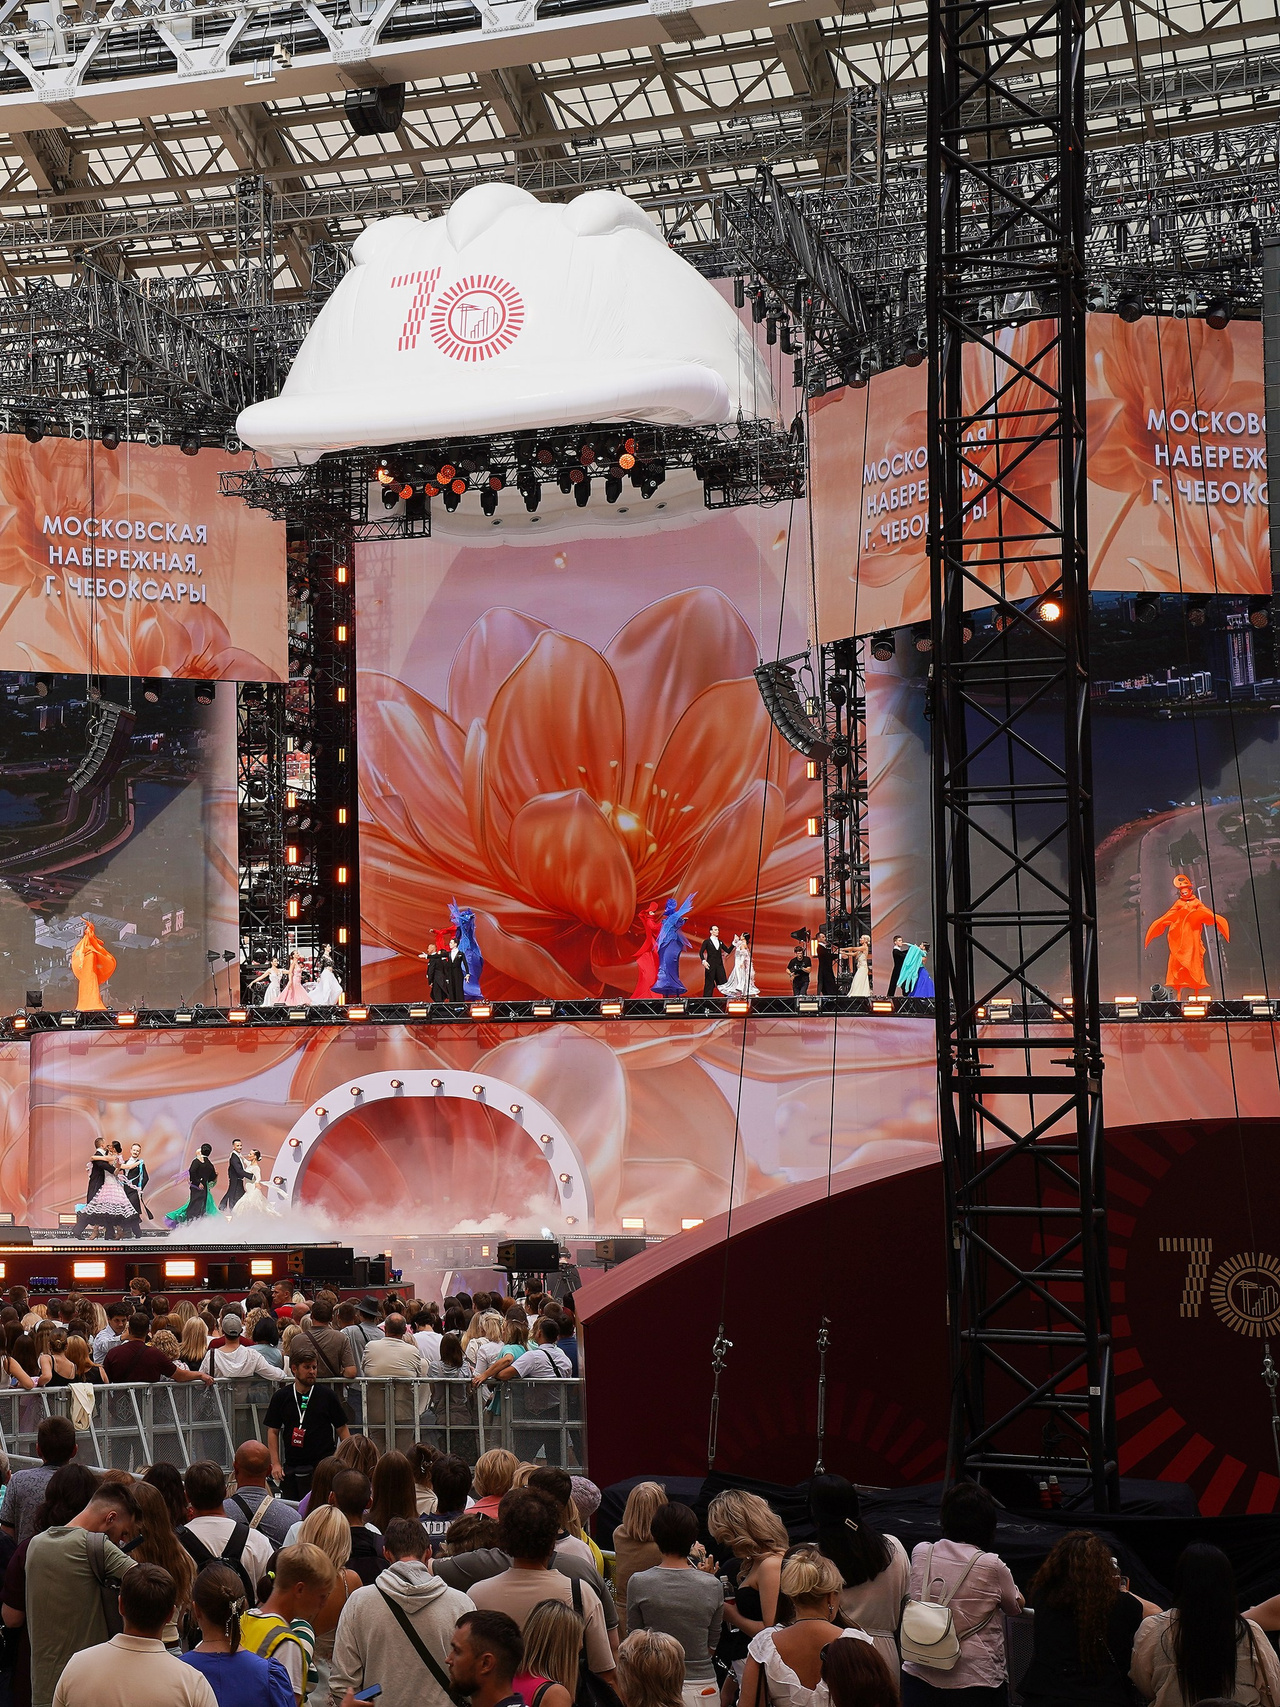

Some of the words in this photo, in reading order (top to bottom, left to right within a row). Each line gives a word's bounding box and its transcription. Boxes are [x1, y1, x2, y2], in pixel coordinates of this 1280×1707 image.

[1147, 409, 1266, 434] МОСКОВ
[863, 427, 987, 485] МОСКОАЯ
[1152, 479, 1170, 501] Г.
[42, 515, 207, 544] МОСКОВСКАЯ
[865, 528, 876, 550] Г.
[49, 545, 203, 576] НАБЕРЕЖНАЯ,
[46, 575, 61, 595] Г.
[69, 576, 206, 603] ЧЕБОКСАРЫ
